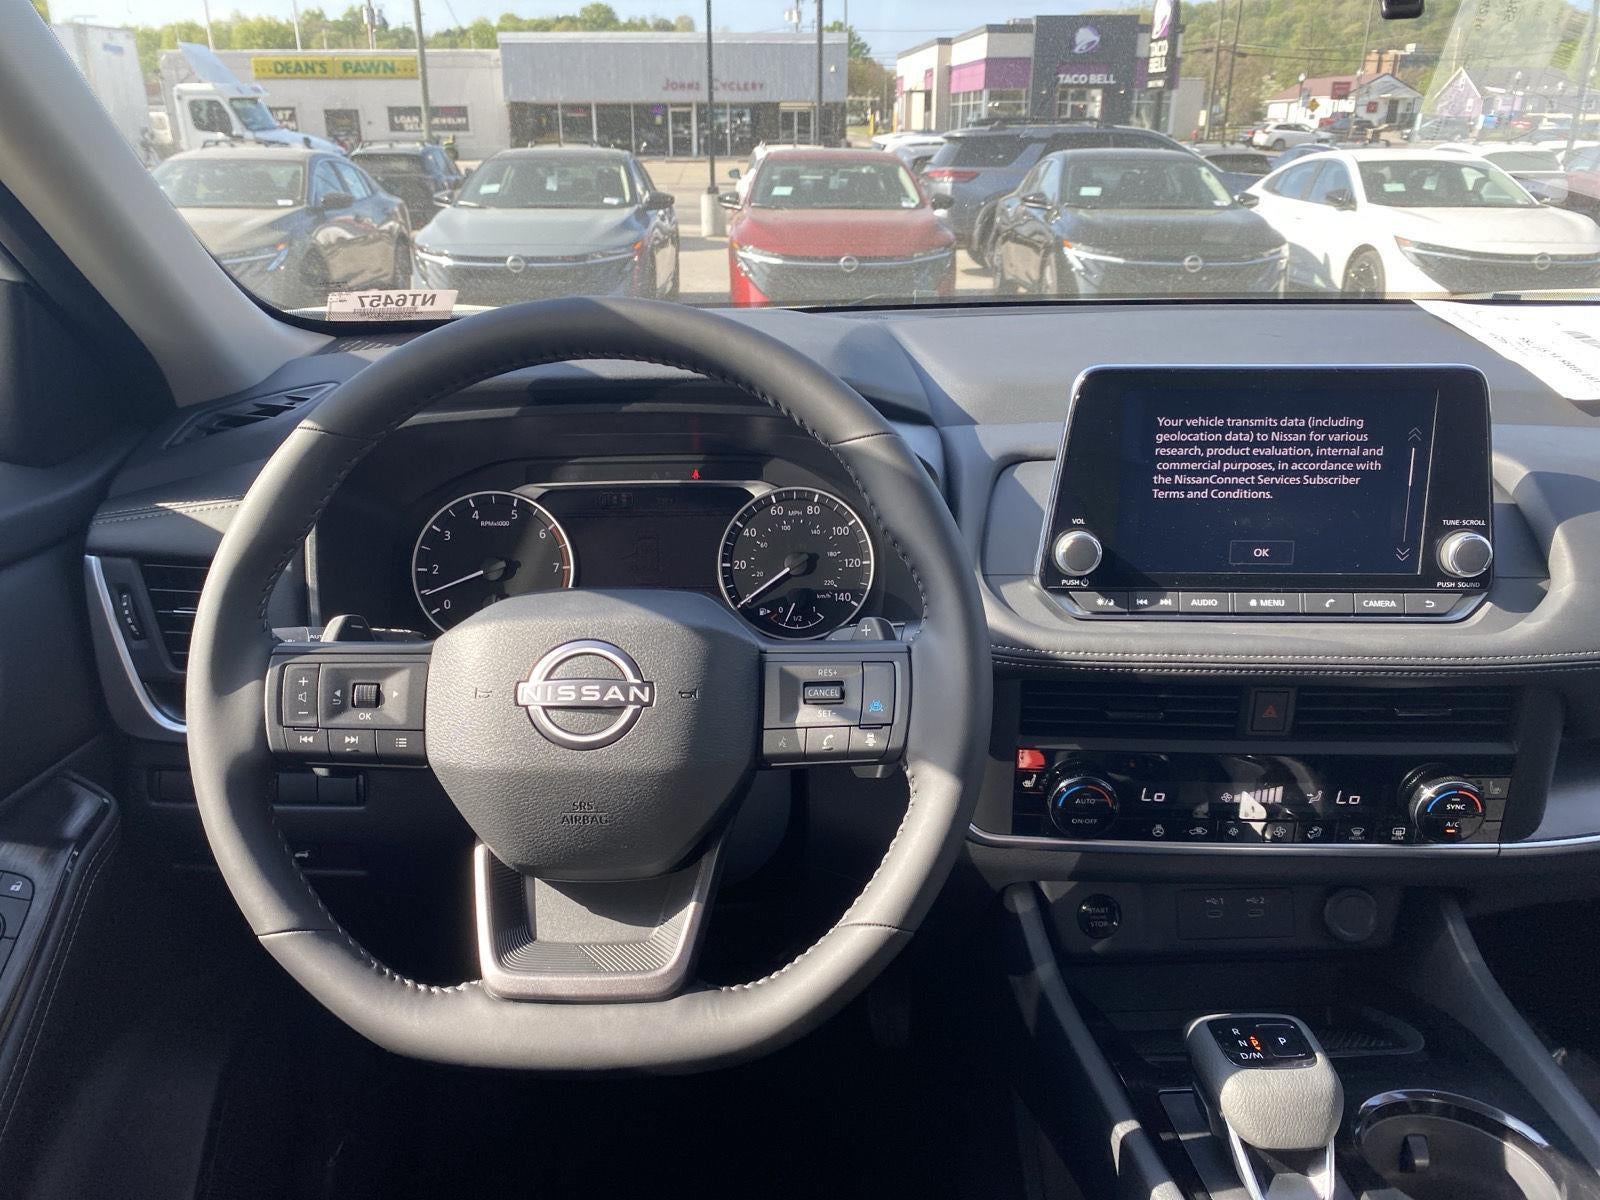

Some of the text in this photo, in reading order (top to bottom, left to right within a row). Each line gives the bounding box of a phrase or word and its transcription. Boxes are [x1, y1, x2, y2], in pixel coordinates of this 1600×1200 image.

[272, 60, 396, 74] DEAN'S PAWN
[1058, 74, 1116, 84] TACO BELL
[1158, 417, 1364, 429] Your vehicle transmits data (including
[1156, 431, 1368, 444] geolocation data) to Nissan for various
[1155, 446, 1383, 458] research, product evaluation, internal and
[1157, 460, 1381, 472] commercial purposes, in accordance with
[1153, 475, 1360, 484] the NissanConnect Services Subscriber
[1152, 489, 1272, 499] Terms and Conditions.
[511, 510, 518, 519] 5
[771, 507, 783, 515] 60
[807, 506, 820, 515] 80
[472, 511, 479, 520] 4
[444, 531, 451, 540] 3
[539, 529, 546, 538] 6
[743, 529, 756, 537] 40
[832, 527, 849, 536] 100
[1254, 549, 1269, 557] OK
[734, 561, 746, 569] 20
[844, 558, 861, 567] 120
[433, 565, 439, 574] 2
[553, 563, 559, 572] 7
[834, 593, 851, 602] 140
[444, 600, 450, 609] 0
[521, 685, 649, 702] NISSAN
[1141, 788, 1166, 802] Lo
[1336, 790, 1360, 805] Lo
[572, 802, 594, 812] SRS
[561, 815, 608, 825] AIRBAG
